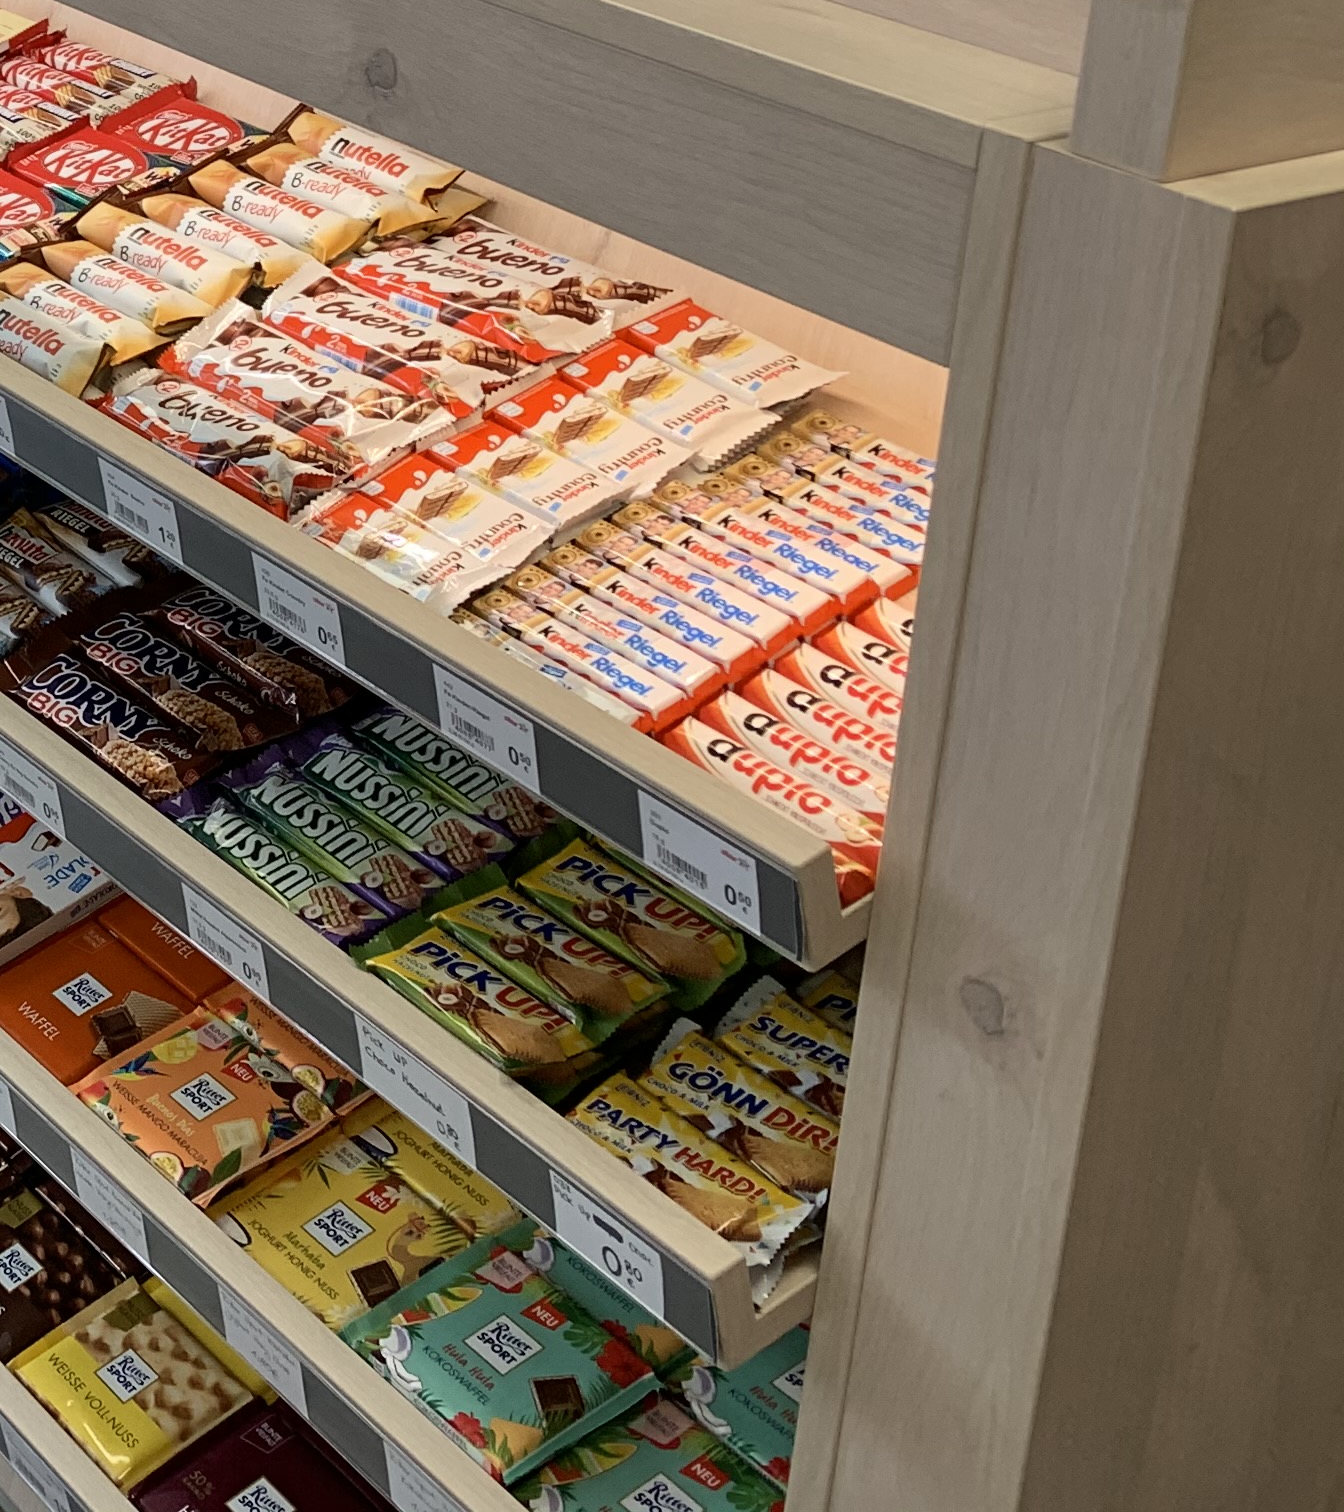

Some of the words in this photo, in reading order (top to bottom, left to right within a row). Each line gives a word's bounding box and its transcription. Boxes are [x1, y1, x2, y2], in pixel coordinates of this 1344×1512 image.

[333, 133, 410, 179] nutella
[230, 194, 284, 227] B-ready
[243, 177, 326, 220] nutella
[129, 226, 209, 273] nutella
[29, 295, 82, 323] B-ready
[316, 297, 428, 342] bueno
[232, 344, 332, 390] bueno
[660, 608, 722, 649] Riegel
[82, 611, 224, 693] CORNY
[86, 641, 139, 677] BIG
[31, 653, 161, 740] CORNY
[592, 656, 653, 697] Riegel
[27, 689, 80, 728] BIG
[152, 734, 194, 761] Schoko
[557, 854, 649, 907] PiCK
[644, 894, 722, 943] UP!
[149, 920, 194, 960] WAFFEL
[411, 938, 494, 994] PiCK
[494, 983, 571, 1034] UP!
[18, 1001, 61, 1041] WAFFEL
[750, 1016, 849, 1074] SUPER
[231, 1062, 252, 1082] NEU
[112, 1080, 141, 1108] WEISSE
[138, 1103, 173, 1133] MANGO
[167, 1129, 209, 1166] MARACUJA
[181, 1089, 213, 1114] SPORT
[668, 1062, 768, 1118] GÖNN
[762, 1106, 840, 1155] DiR!
[393, 1129, 435, 1161] JOGHURT
[432, 1160, 463, 1186] HONIG
[464, 1183, 490, 1206] NUSS
[586, 1098, 681, 1153] PARTY
[674, 1146, 768, 1204] HARD!
[365, 1191, 389, 1211] NEU
[248, 1218, 287, 1253] JOGHURT
[284, 1250, 316, 1280] HONIG
[314, 1277, 340, 1300] NUSS
[282, 1230, 326, 1270] Marhaba
[566, 1255, 635, 1314] KOKOSWAFFEL
[490, 1321, 533, 1359] Ritter
[105, 1366, 137, 1393] SPORT
[118, 1357, 152, 1386] Ritter
[421, 1344, 491, 1408] KOKOSWAFFEL
[47, 1352, 88, 1395] WEISSE
[83, 1391, 139, 1449] VOLL-NUSS
